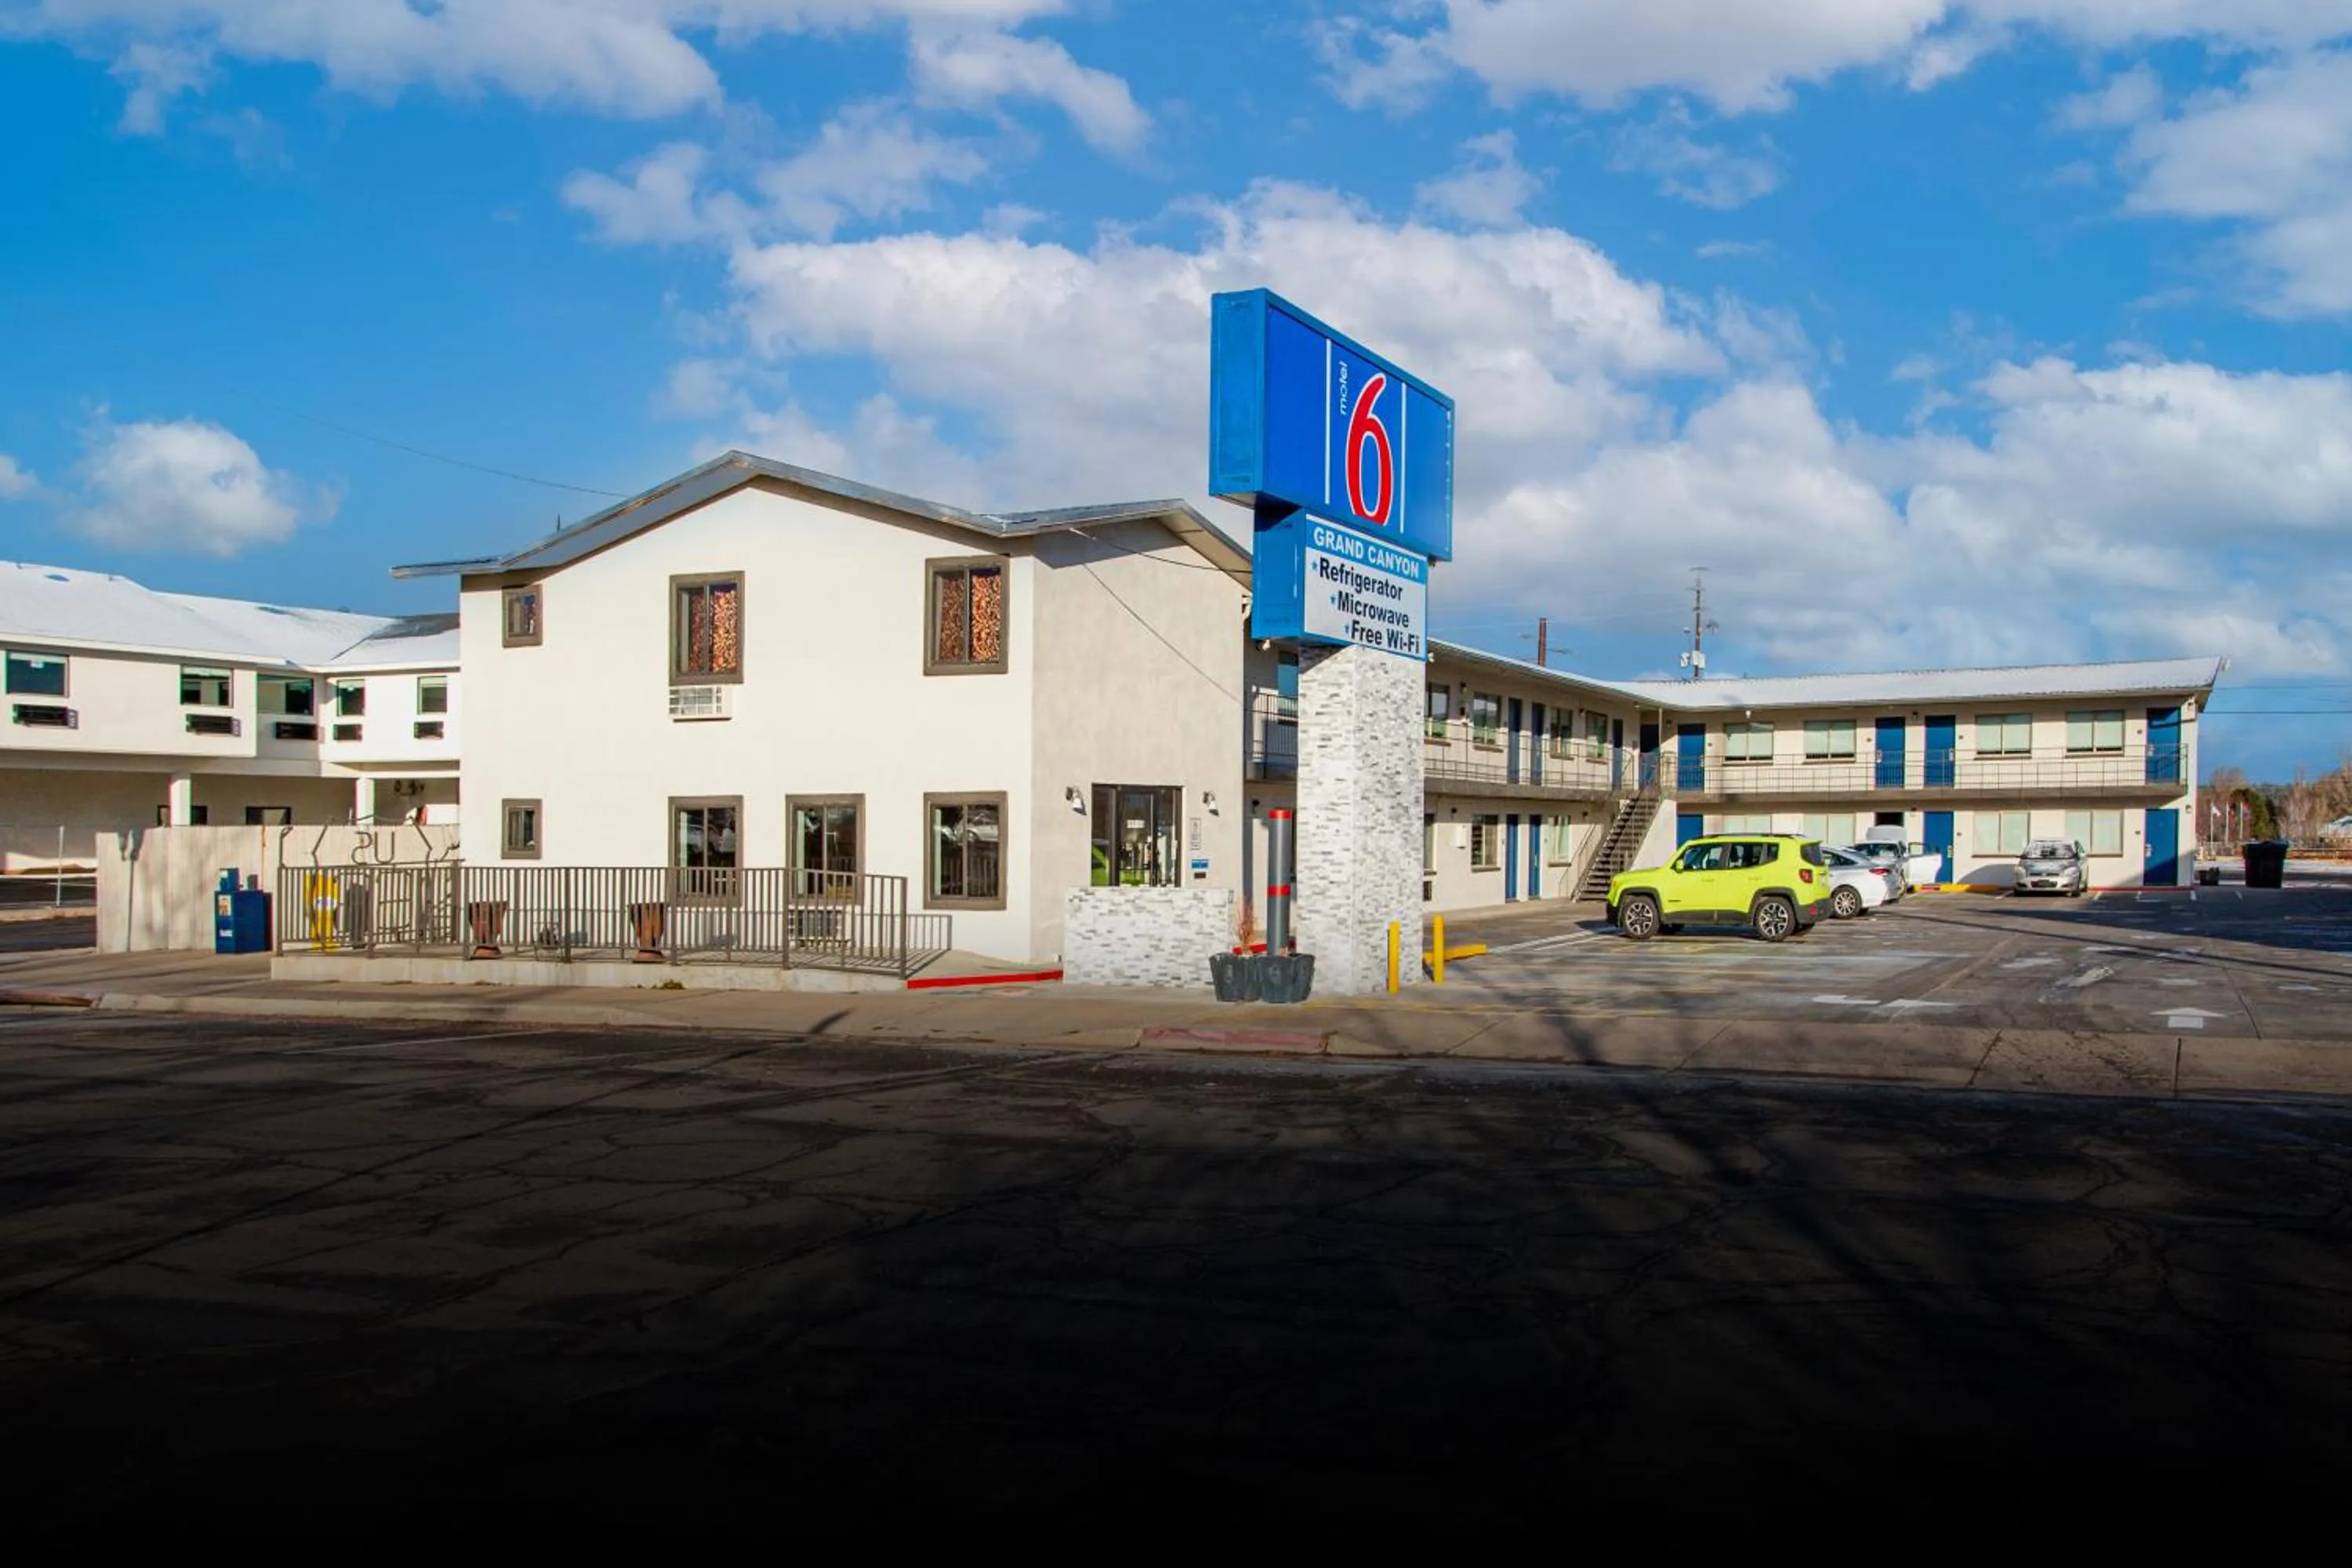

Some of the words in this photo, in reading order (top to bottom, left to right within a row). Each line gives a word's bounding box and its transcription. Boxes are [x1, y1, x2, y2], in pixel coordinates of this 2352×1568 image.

[1339, 361, 1348, 416] motel
[1345, 372, 1394, 527] 6
[1313, 526, 1364, 559] GRAND
[1367, 546, 1419, 578] CANYON
[1319, 556, 1403, 601] Refrigerator
[1338, 590, 1410, 628] Microwave
[1351, 619, 1383, 645] Free
[1386, 628, 1420, 654] Wi-Fi
